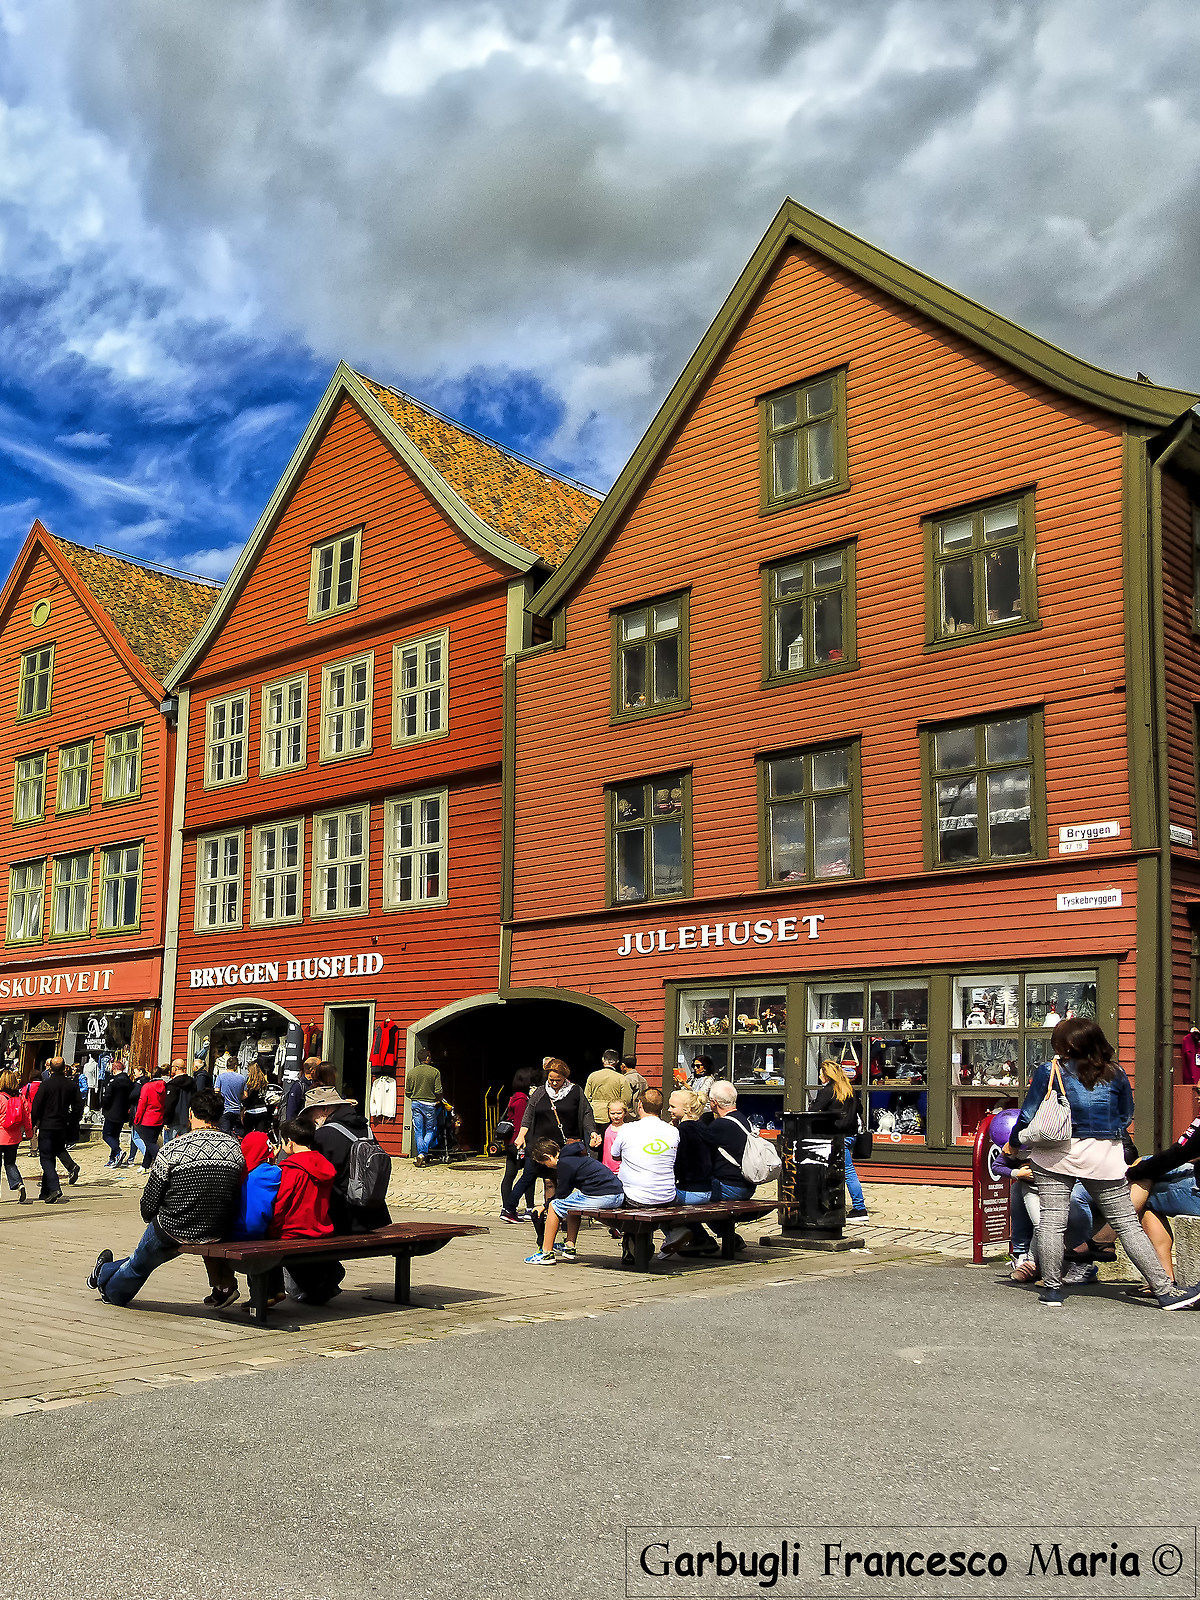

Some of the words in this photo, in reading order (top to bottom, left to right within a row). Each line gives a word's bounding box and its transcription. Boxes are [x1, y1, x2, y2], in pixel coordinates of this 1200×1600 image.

[1066, 826, 1111, 839] Bryggen
[1062, 895, 1117, 907] Tyskebryggen
[617, 914, 825, 956] JULEHUSET
[189, 961, 280, 989] BRYGGEN
[286, 952, 384, 981] HUSFLID
